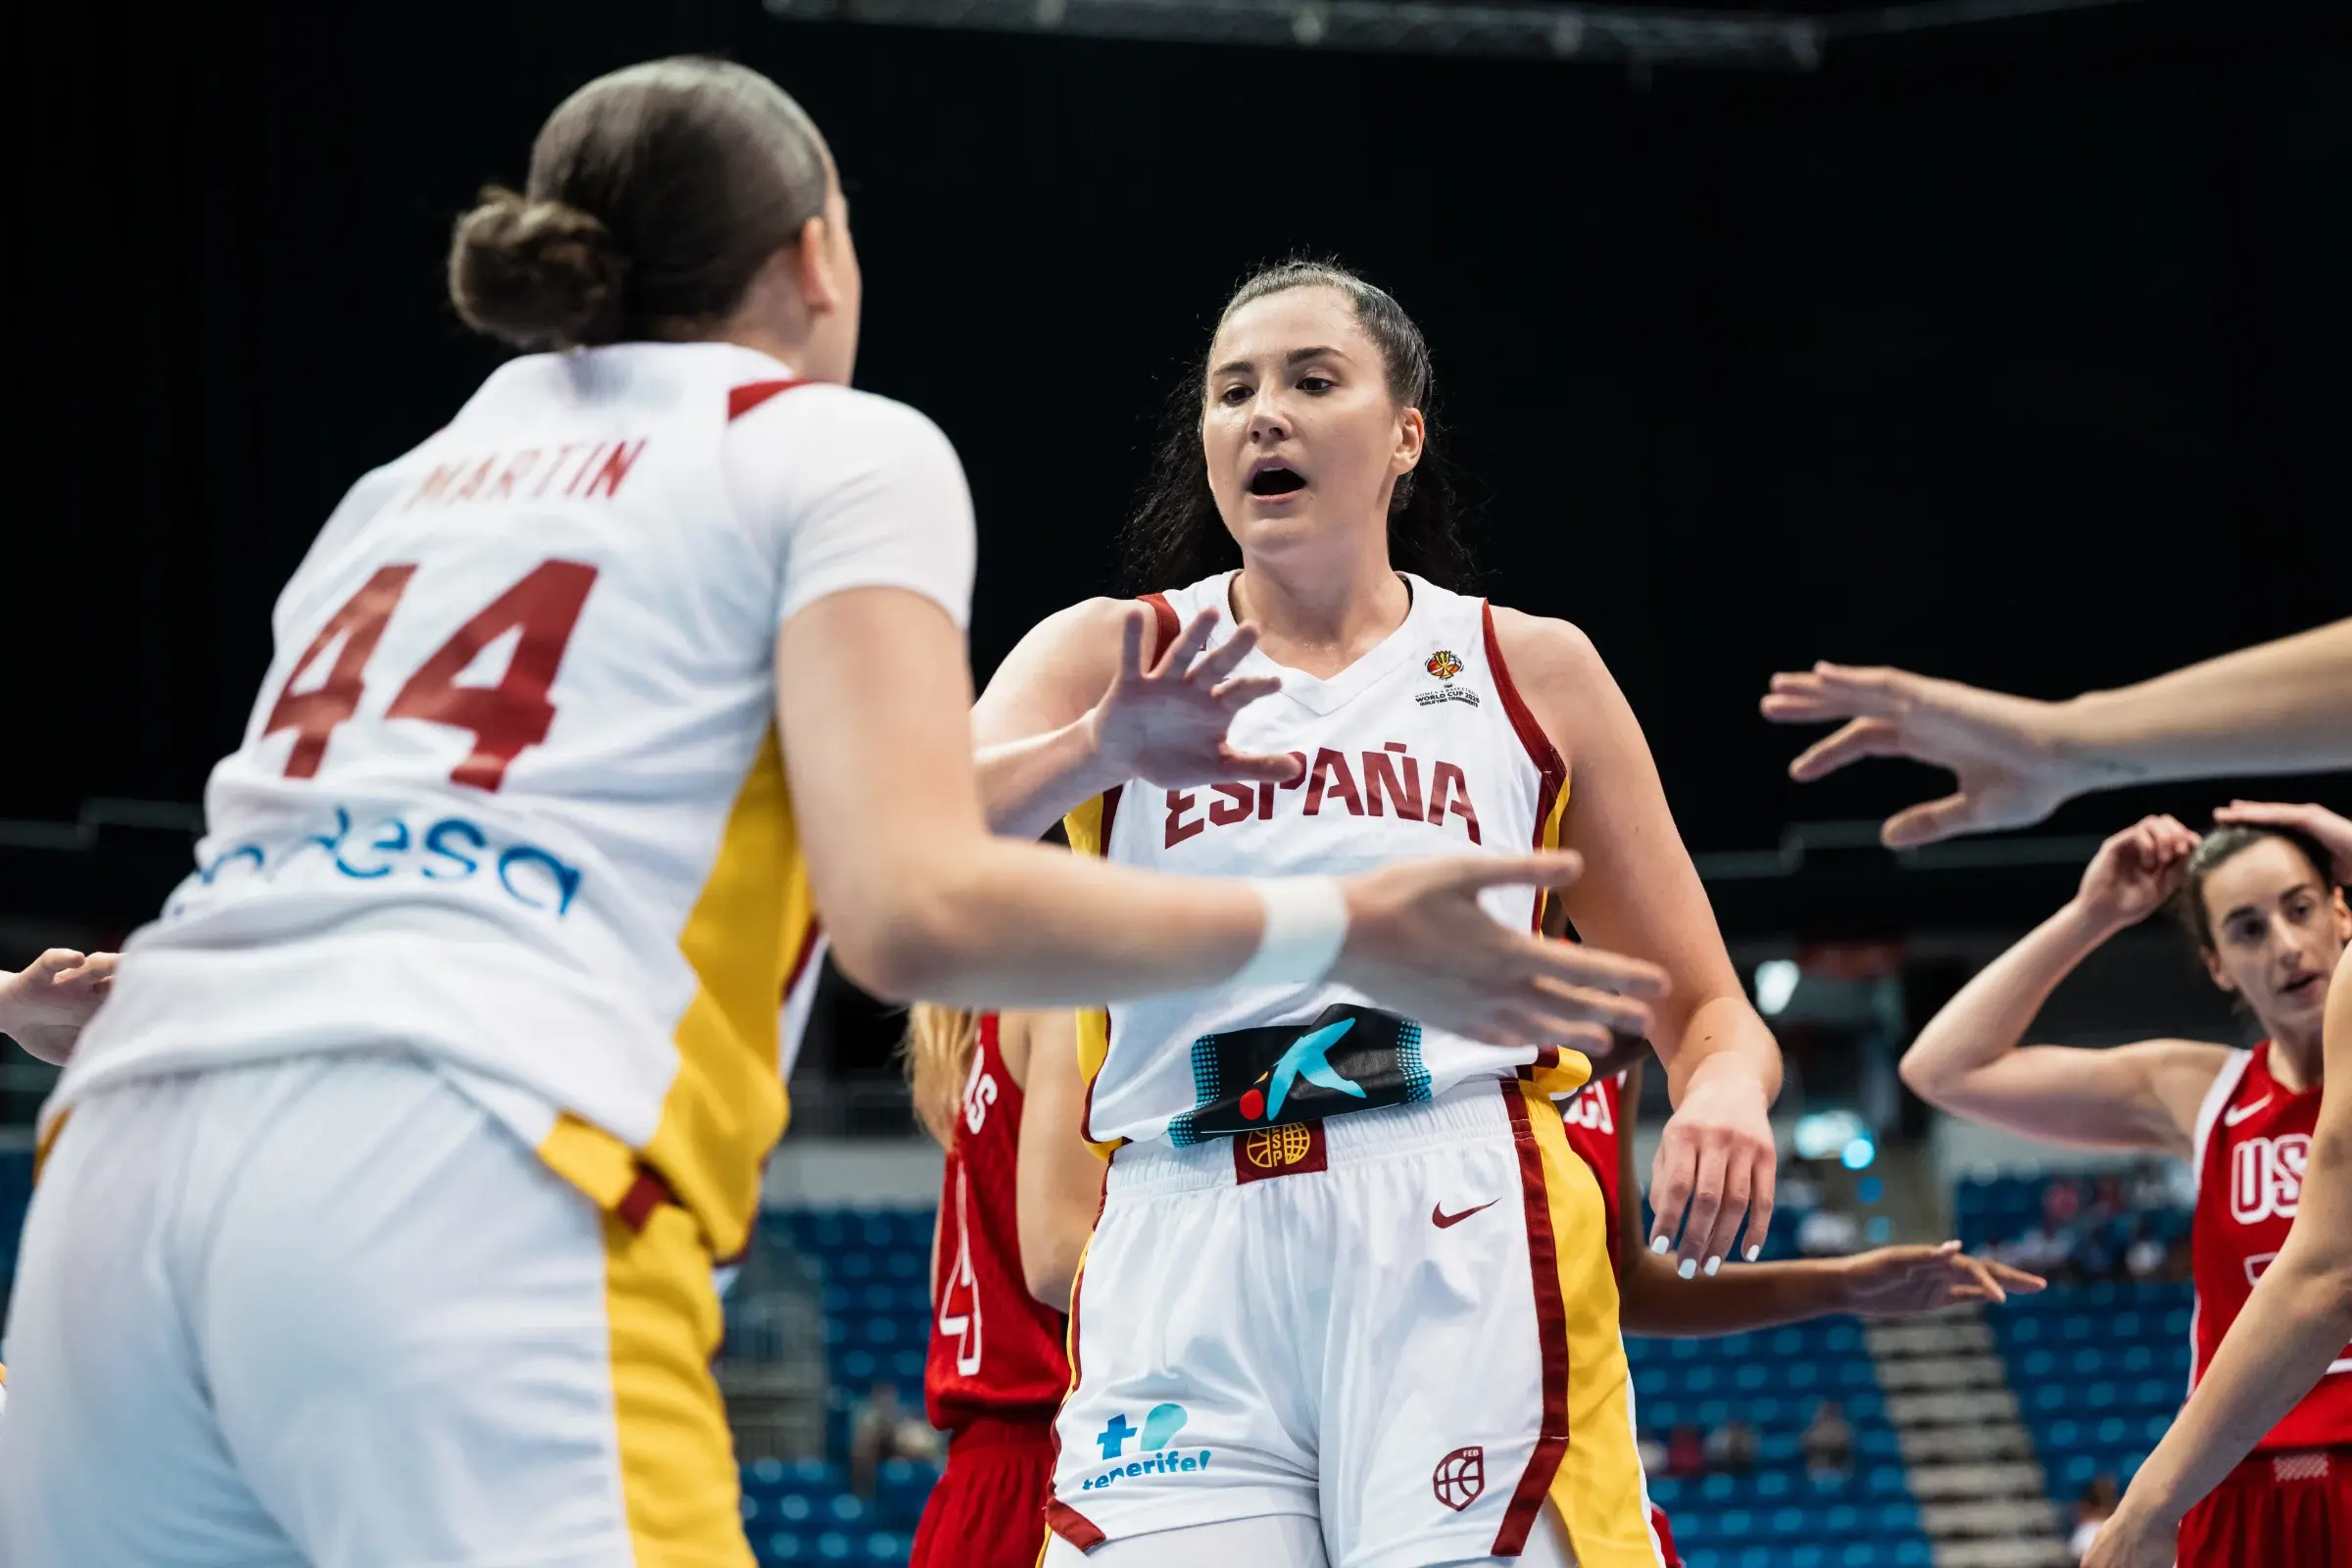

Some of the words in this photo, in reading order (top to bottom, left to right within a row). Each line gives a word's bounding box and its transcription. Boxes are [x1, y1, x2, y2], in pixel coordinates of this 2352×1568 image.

[261, 557, 600, 794] 44
[1415, 693, 1446, 703] WORLD
[1465, 692, 1480, 704] 2026
[1164, 741, 1483, 851] ESPAÑA
[2230, 1133, 2311, 1225] US
[1462, 1448, 1480, 1458] FEB
